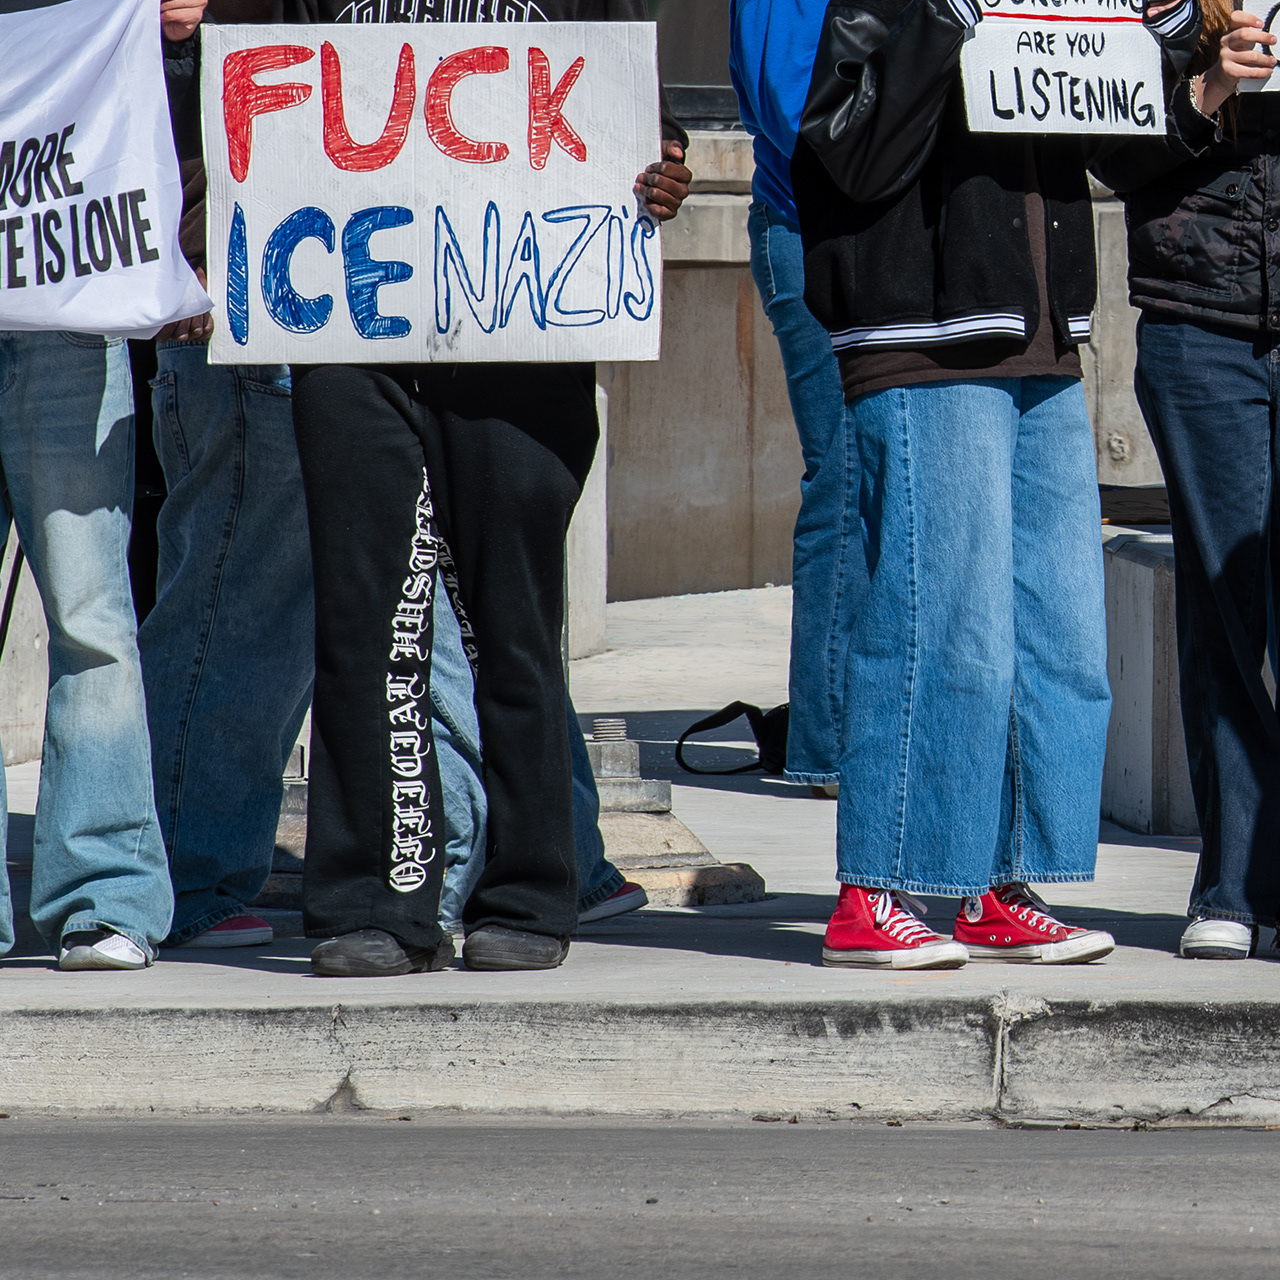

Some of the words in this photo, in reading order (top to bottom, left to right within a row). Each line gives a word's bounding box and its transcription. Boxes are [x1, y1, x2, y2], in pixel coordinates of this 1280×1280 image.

[1017, 32, 1057, 56] ARE
[1065, 31, 1106, 57] YOU
[222, 39, 588, 184] FUCK
[989, 67, 1156, 127] LISTENING
[31, 209, 66, 286] IS
[69, 188, 160, 278] LOVE
[226, 203, 414, 346] ICE
